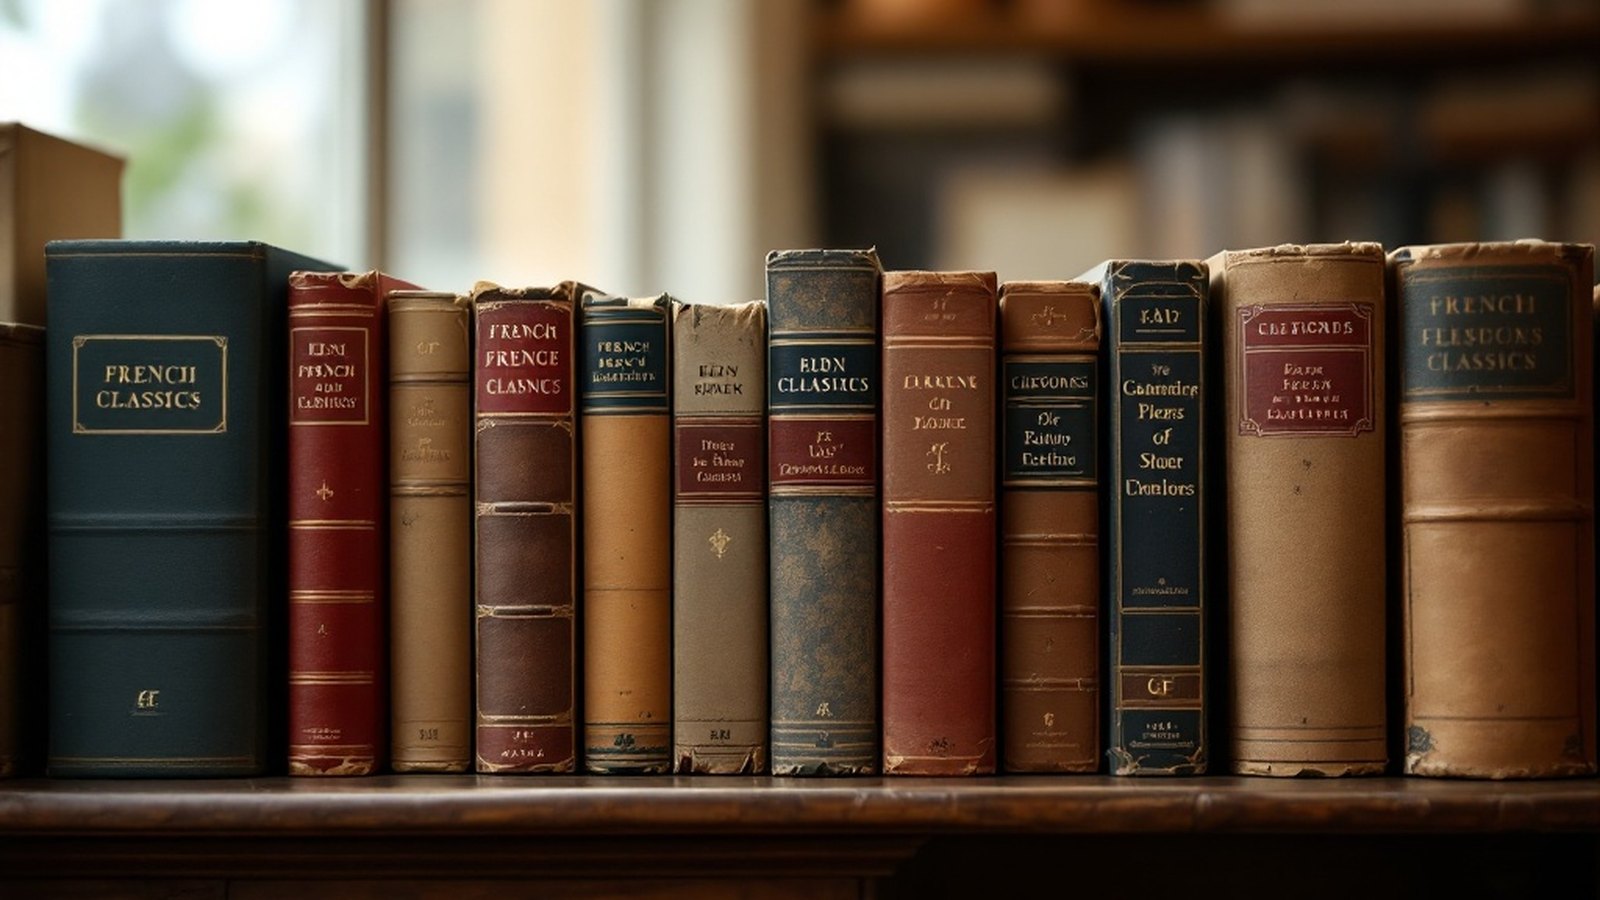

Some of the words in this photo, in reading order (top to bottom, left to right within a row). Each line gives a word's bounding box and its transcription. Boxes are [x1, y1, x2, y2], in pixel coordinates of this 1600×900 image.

[1431, 295, 1535, 316] FRENCH
[1427, 352, 1536, 372] CLASSICS
[104, 365, 196, 384] FRENCH
[96, 390, 201, 410] CLASSICS
[1152, 428, 1173, 446] of
